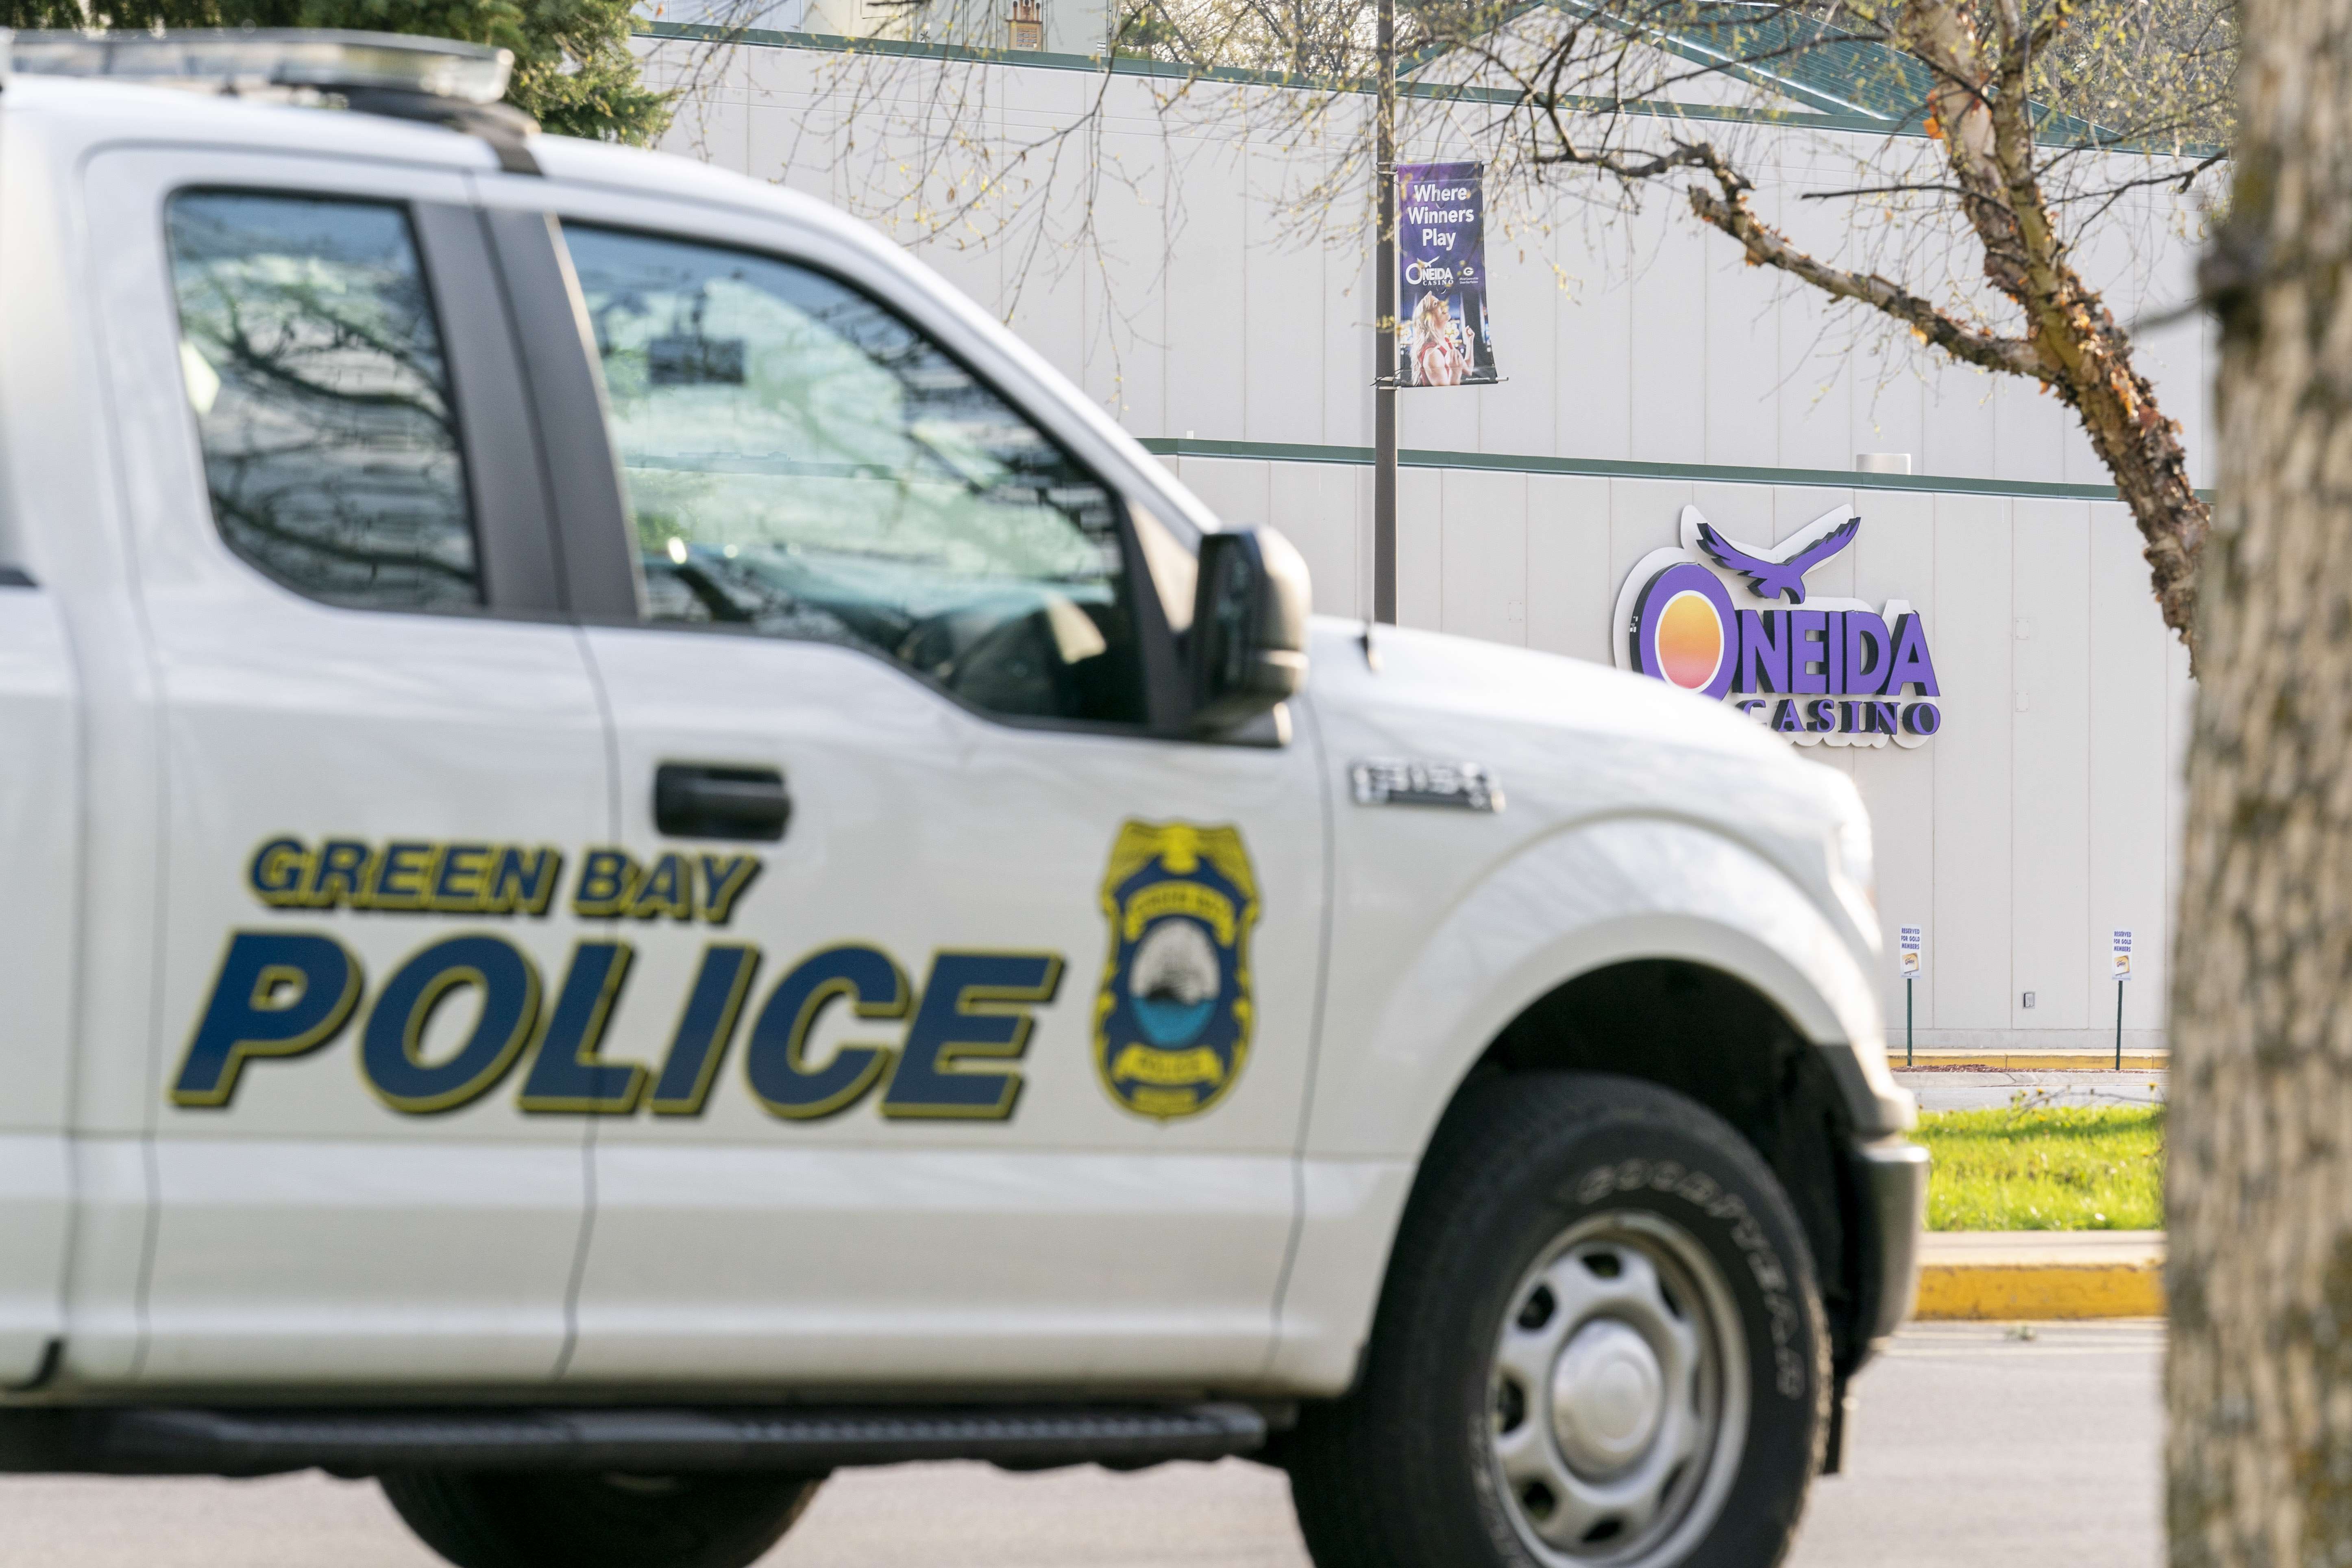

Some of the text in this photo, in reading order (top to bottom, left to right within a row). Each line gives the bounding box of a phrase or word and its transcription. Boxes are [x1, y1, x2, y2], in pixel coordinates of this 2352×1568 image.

[1414, 184, 1467, 202] Where
[1407, 207, 1474, 224] Winners
[1422, 228, 1456, 251] Play
[1405, 263, 1453, 285] ONEIDA
[1631, 562, 1940, 702] ONEIDA
[249, 834, 761, 924] GREEN BAY
[168, 929, 1067, 1122] POLICE
